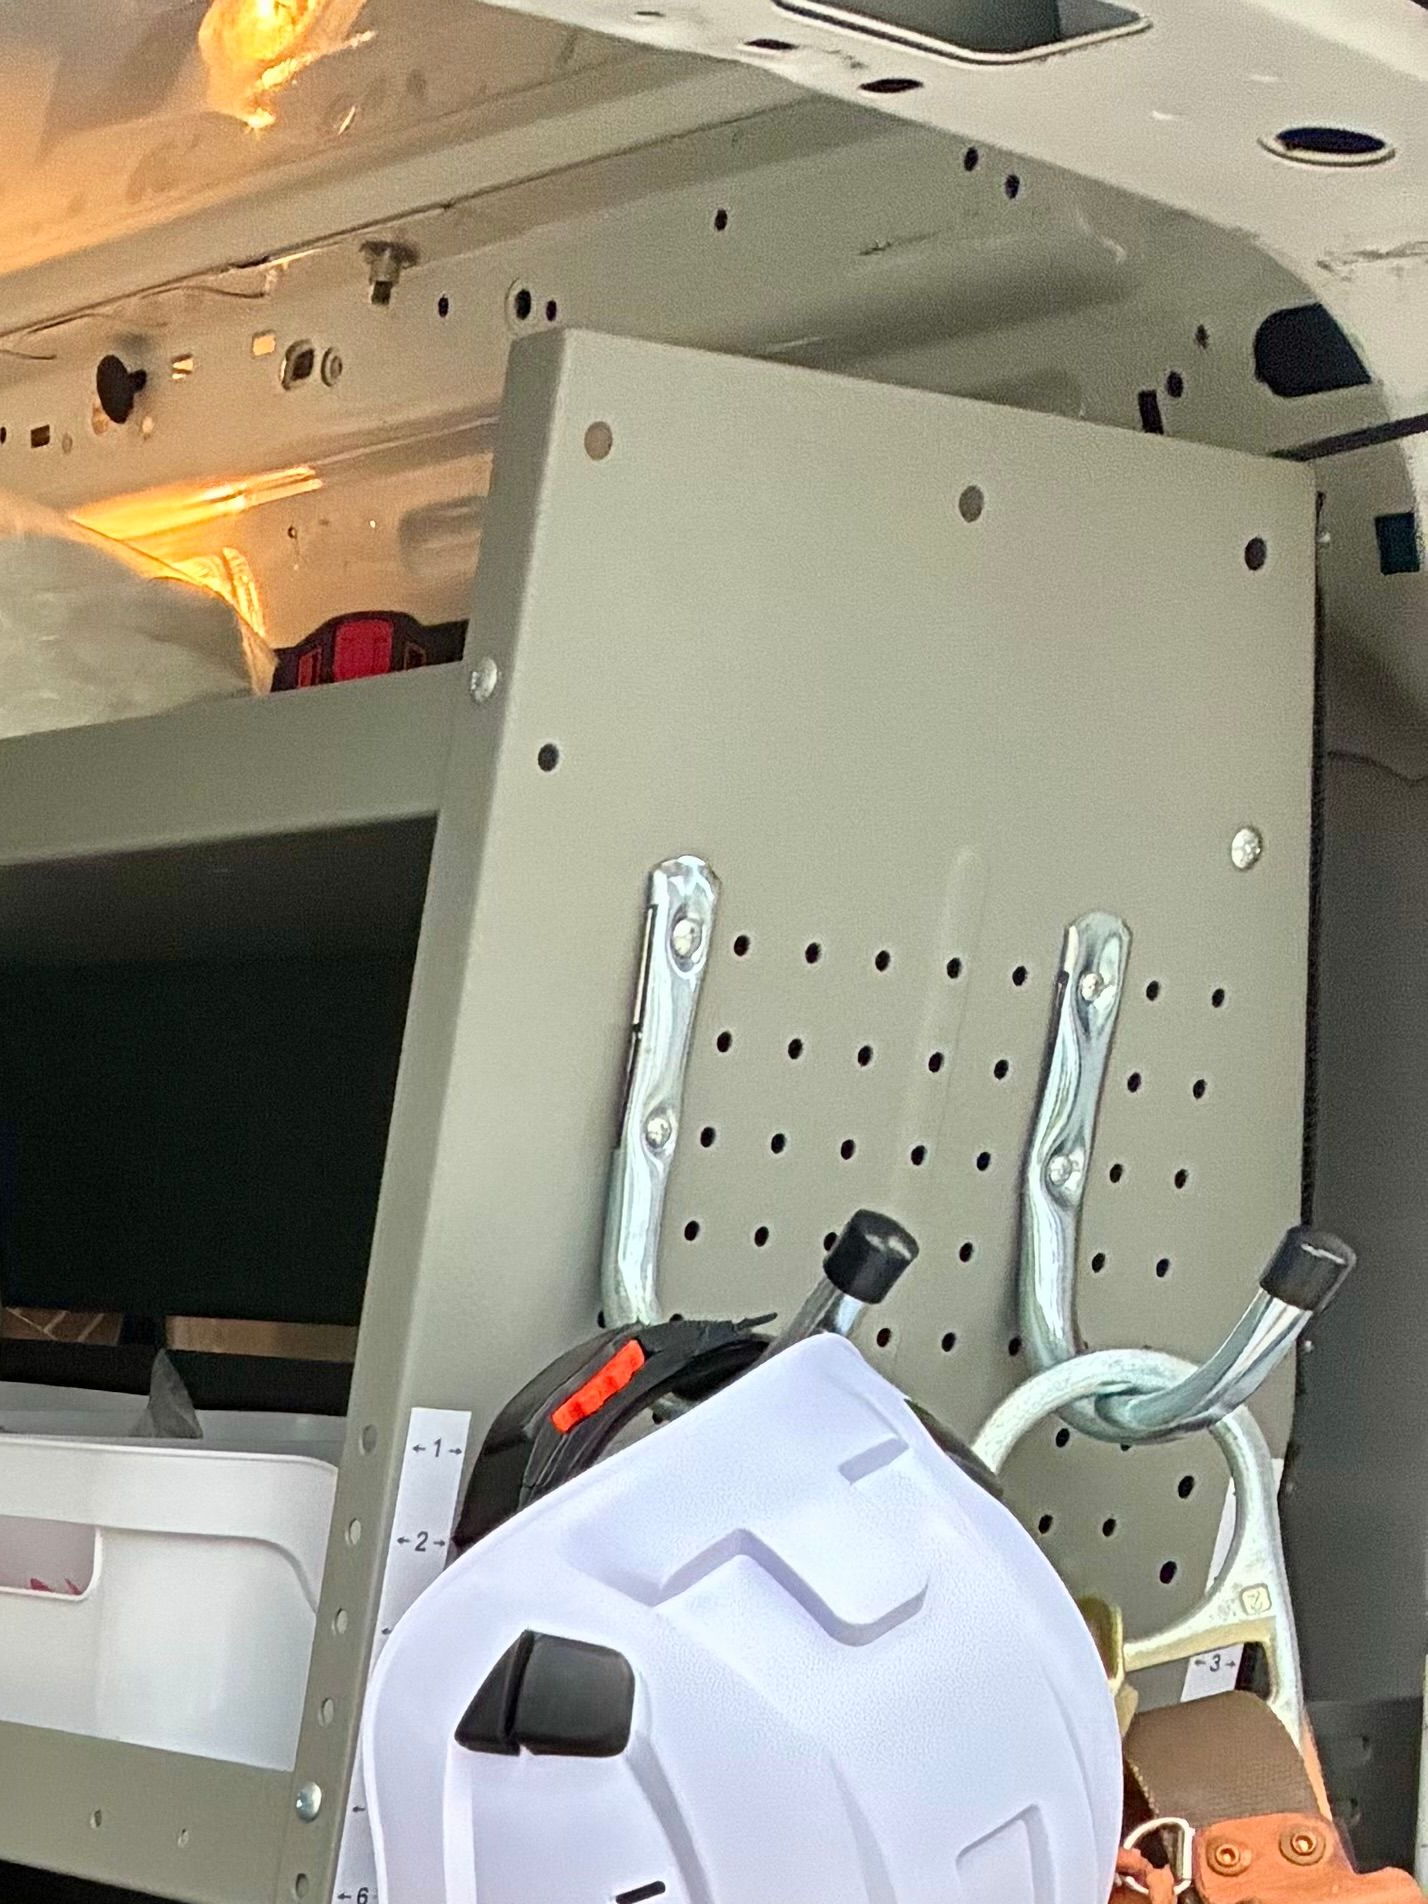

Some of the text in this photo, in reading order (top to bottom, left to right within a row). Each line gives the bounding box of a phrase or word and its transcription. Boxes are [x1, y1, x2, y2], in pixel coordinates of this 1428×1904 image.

[435, 1439, 441, 1457] 1
[415, 1531, 428, 1552] 2
[1209, 1653, 1221, 1673] 3
